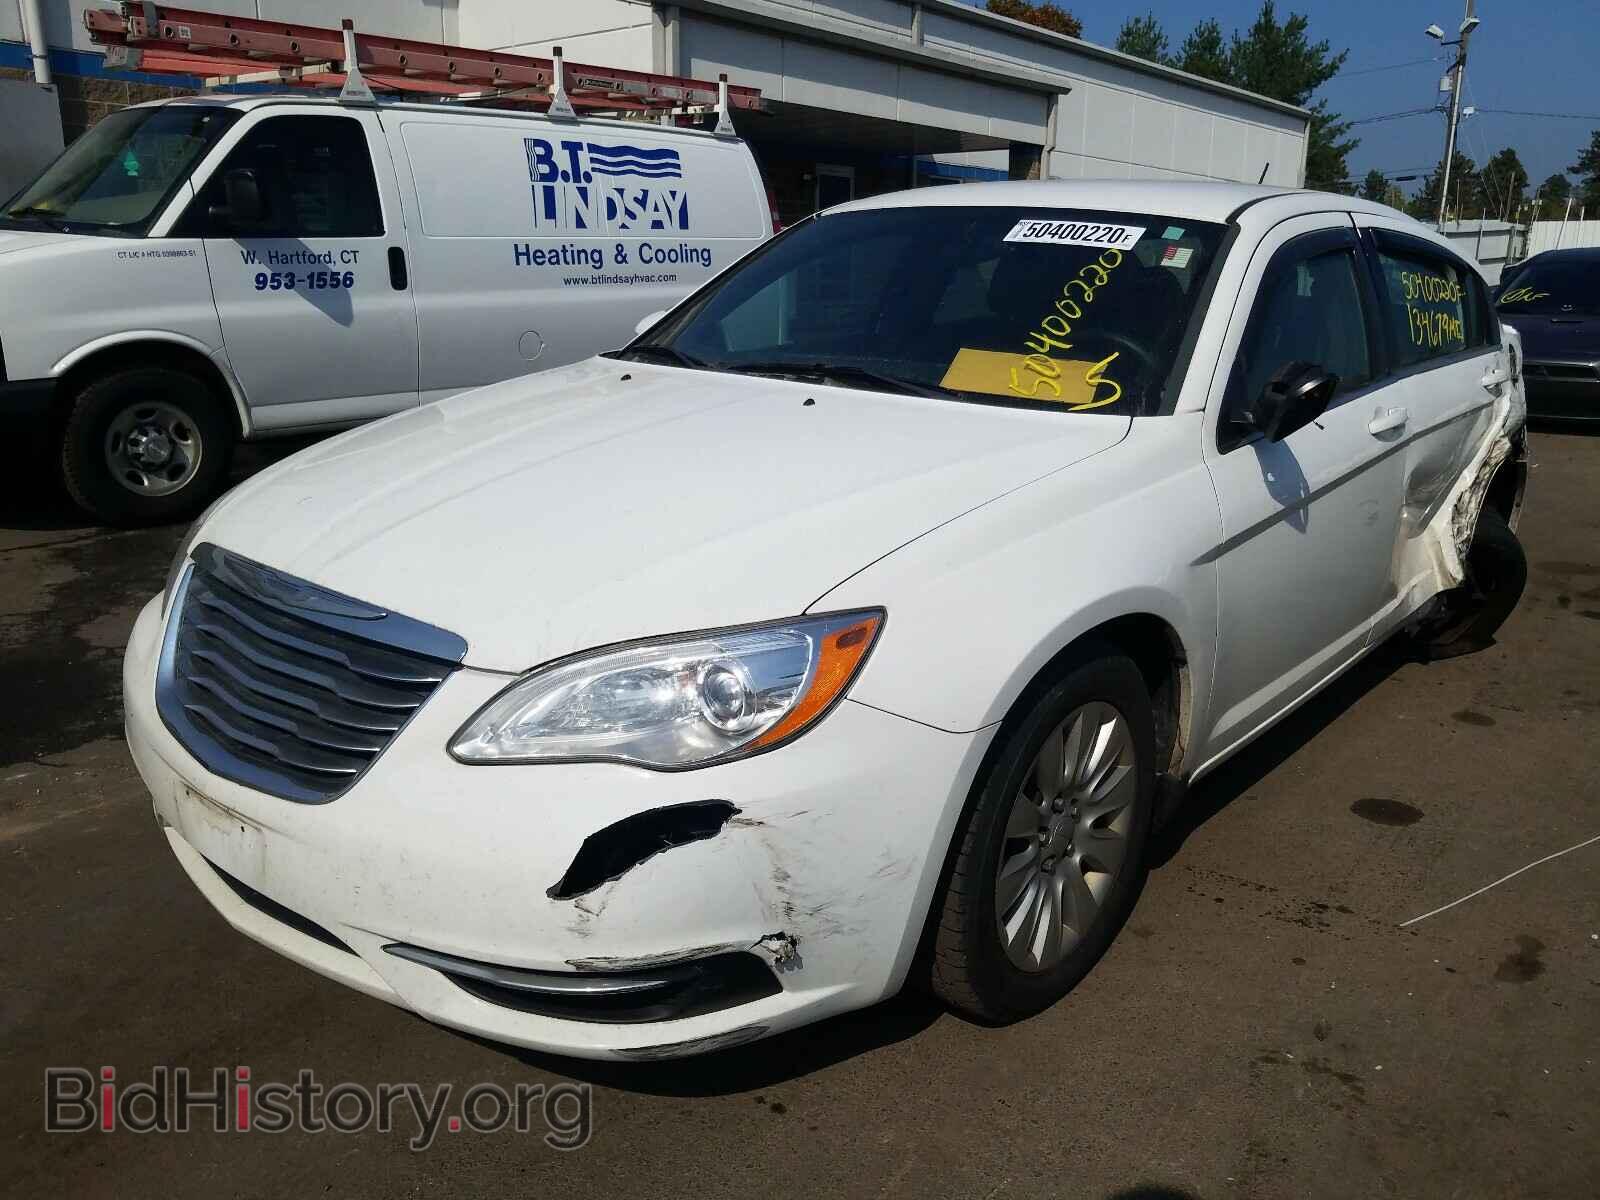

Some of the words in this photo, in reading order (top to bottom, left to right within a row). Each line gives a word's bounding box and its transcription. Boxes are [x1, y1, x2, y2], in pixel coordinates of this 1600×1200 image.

[523, 137, 593, 184] B.T.
[531, 184, 689, 231] LINDSAY
[240, 250, 262, 265] W.
[268, 250, 337, 267] Hartford,
[340, 250, 360, 264] CT
[513, 243, 604, 270] Heating
[614, 243, 629, 265] &
[638, 242, 712, 267] Cooling
[255, 271, 354, 291] 953-1556
[563, 273, 677, 286] www.btlindsayhvac.com
